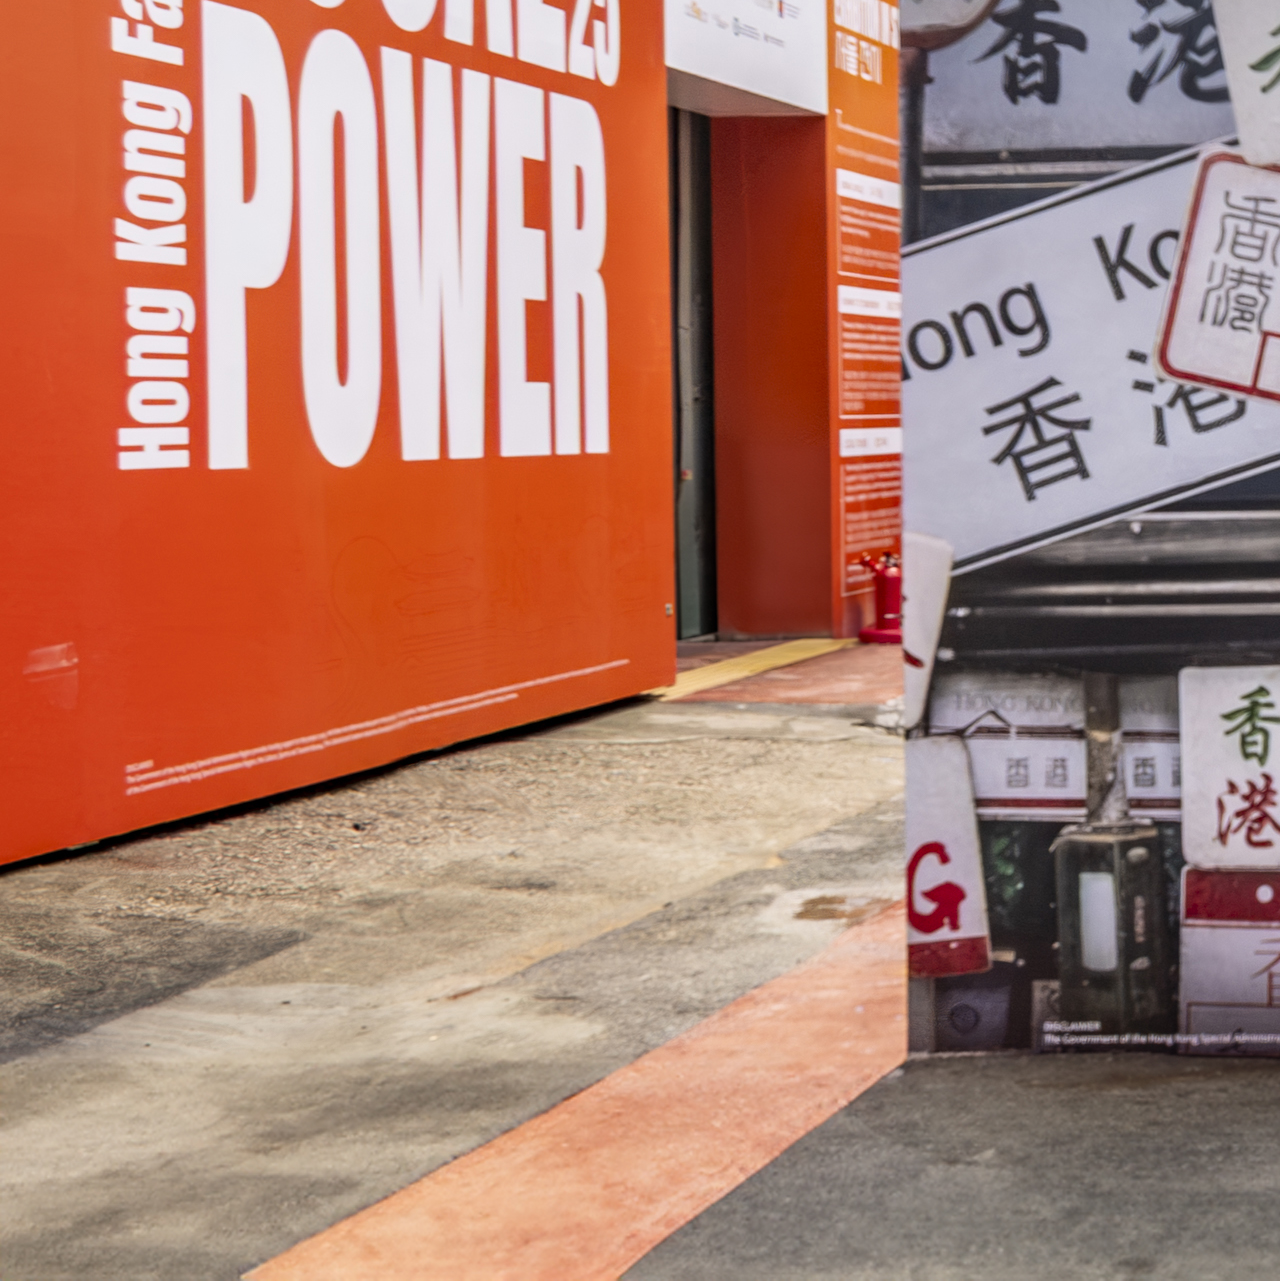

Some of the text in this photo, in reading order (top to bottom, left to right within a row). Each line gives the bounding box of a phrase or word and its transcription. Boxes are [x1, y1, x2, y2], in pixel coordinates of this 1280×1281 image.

[113, 79, 193, 267] Kong
[117, 285, 196, 471] Hong
[901, 281, 1051, 383] ong
